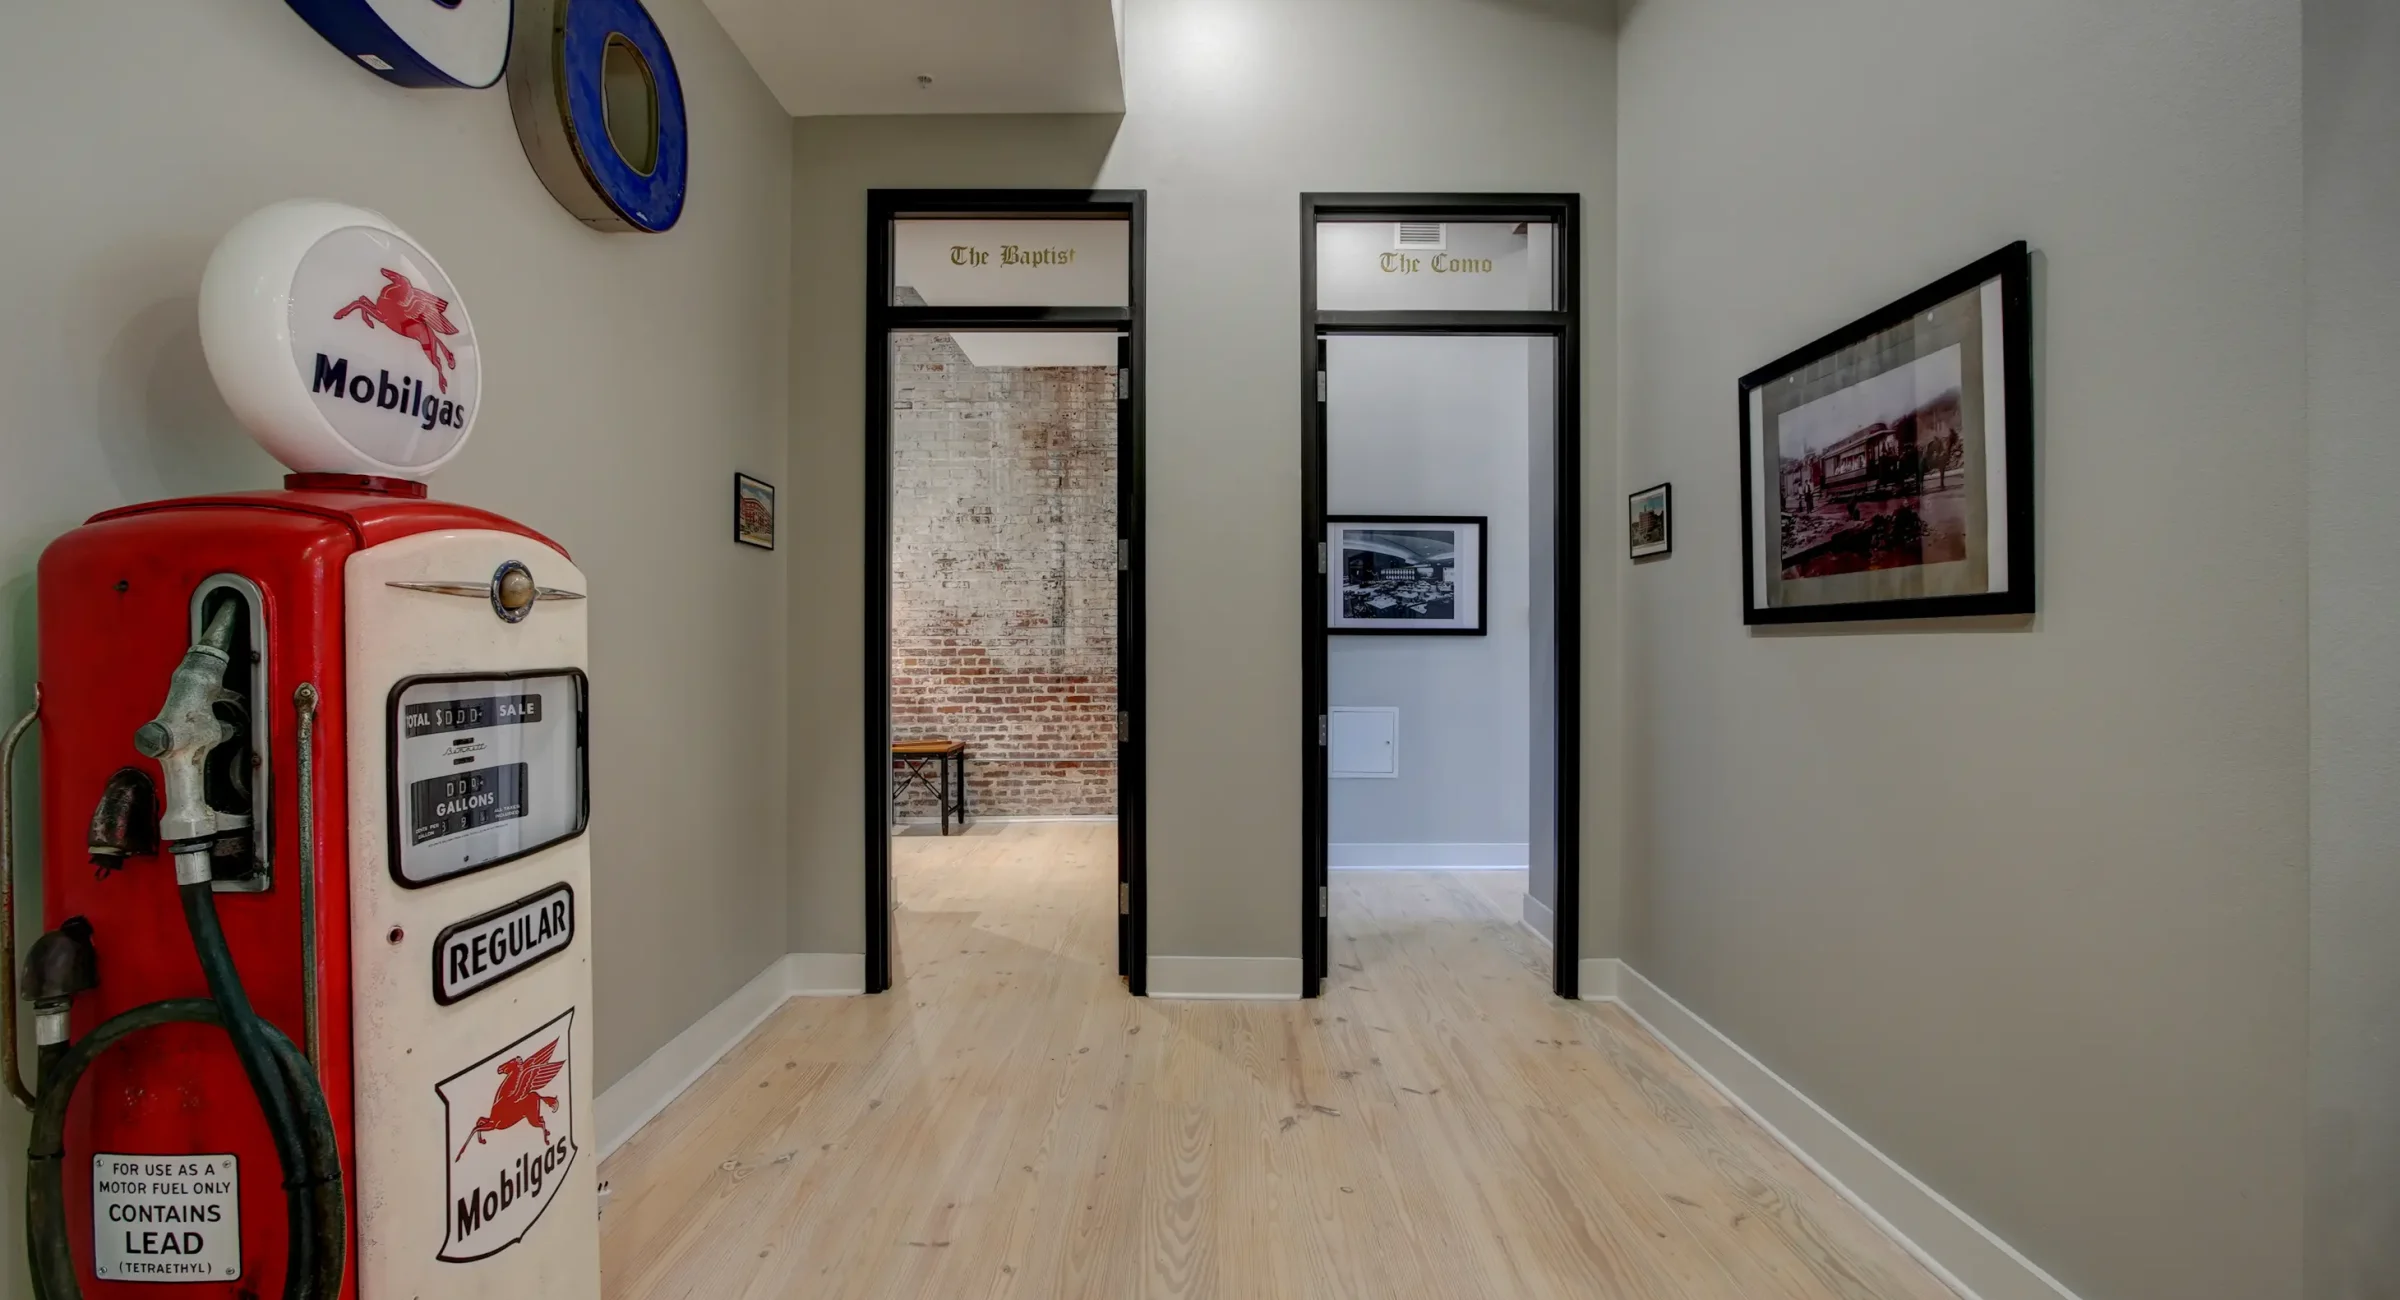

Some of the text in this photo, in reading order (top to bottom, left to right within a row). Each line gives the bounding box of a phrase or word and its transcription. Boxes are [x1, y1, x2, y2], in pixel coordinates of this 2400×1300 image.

[950, 245, 1076, 268] The Baptist
[1379, 252, 1492, 275] The Como
[312, 353, 465, 430] Mobilgas
[500, 702, 535, 717] SALE
[436, 792, 495, 817] GALLONS
[450, 899, 566, 986] REGULAR
[113, 1163, 215, 1176] FOR USE AS A
[99, 1181, 231, 1195] MOTOR FUEL ONLY
[457, 1135, 567, 1243] Mobilgas
[109, 1203, 221, 1223] CONTAINS
[126, 1231, 204, 1255] LEAD
